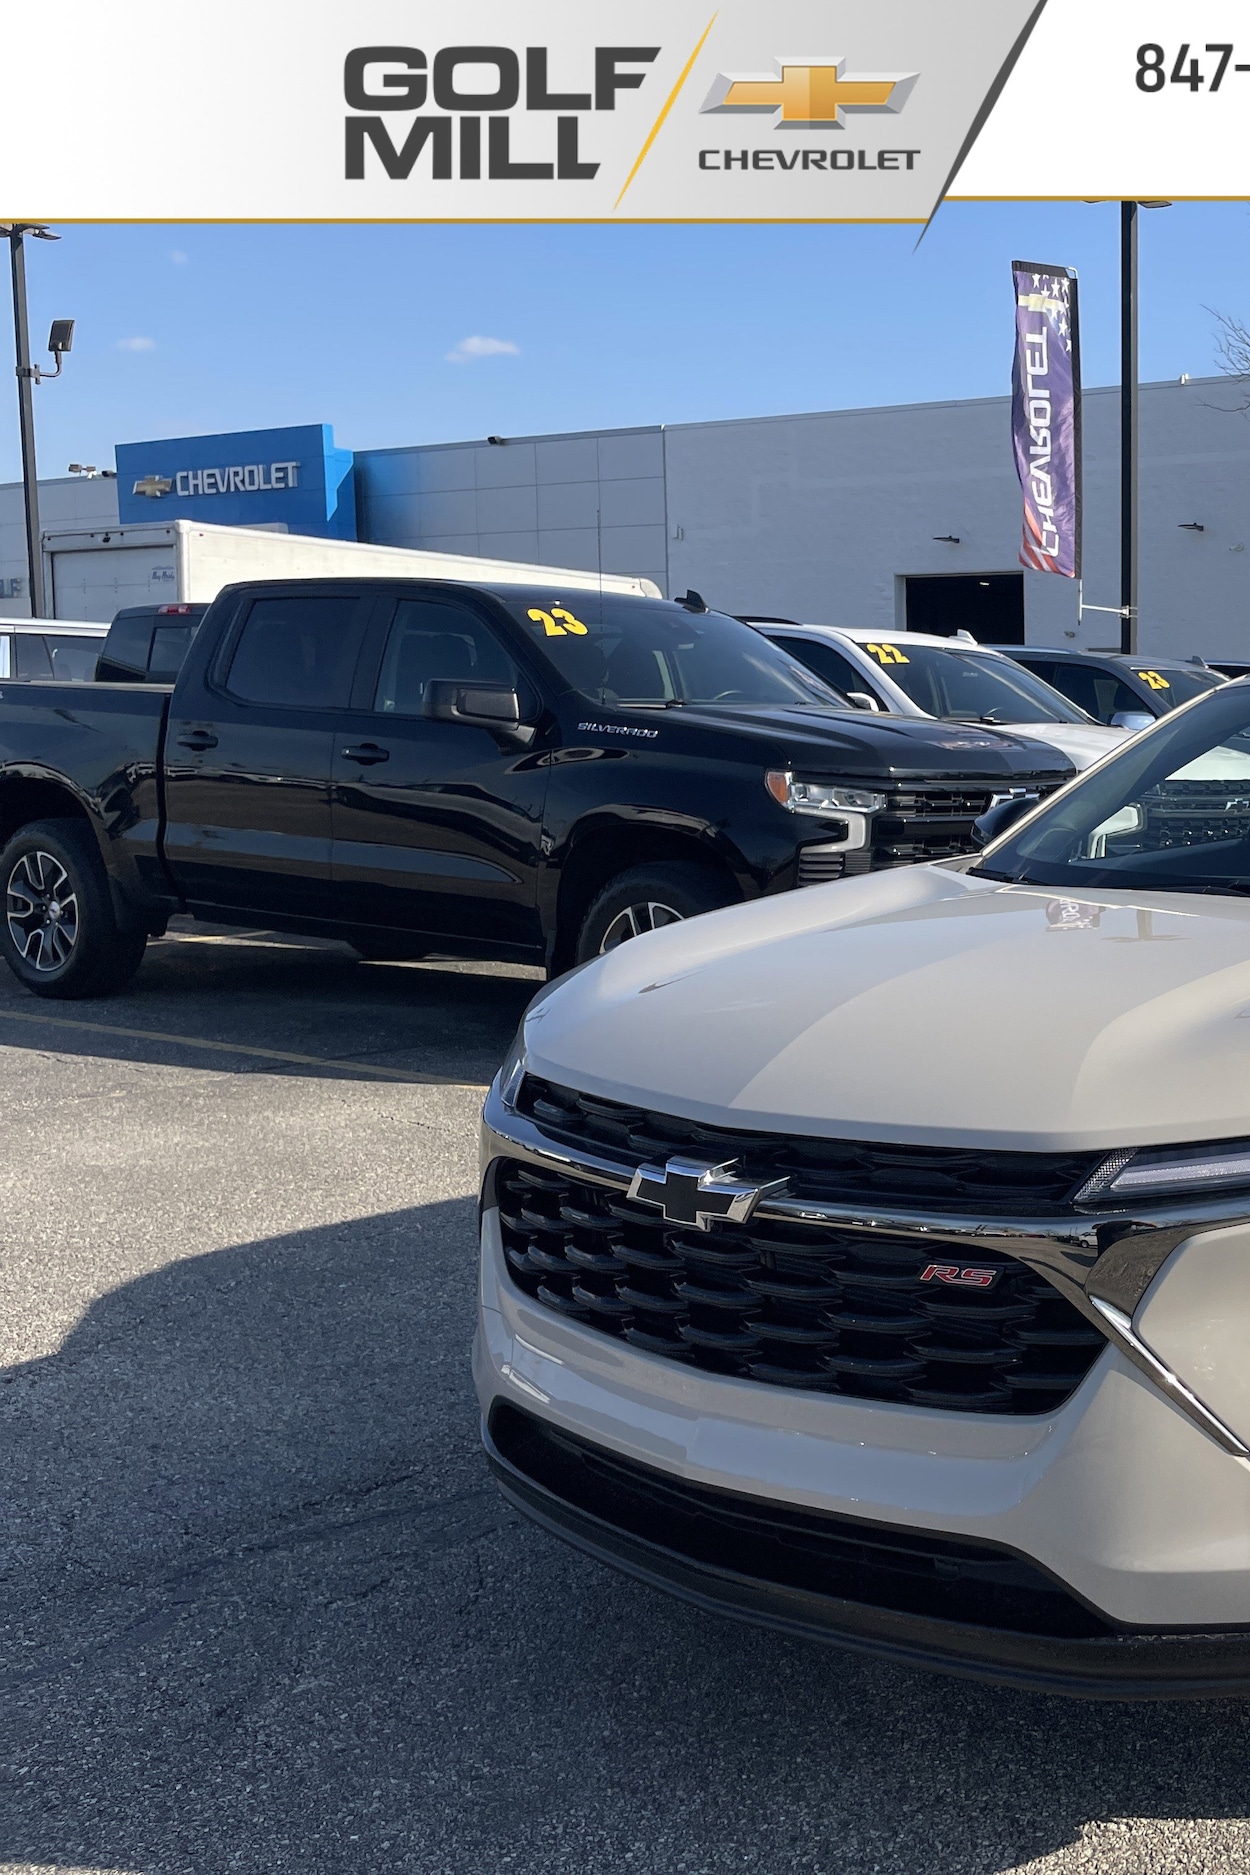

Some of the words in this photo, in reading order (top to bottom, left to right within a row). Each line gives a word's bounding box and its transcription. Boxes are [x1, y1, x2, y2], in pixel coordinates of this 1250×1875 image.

[1025, 326, 1060, 558] CHEVROLET
[175, 461, 300, 497] CHEVROLET
[527, 607, 589, 637] 23
[866, 643, 910, 664] 22
[1138, 670, 1170, 690] 23
[577, 721, 659, 739] SILVERADO
[919, 1264, 997, 1287] RS
